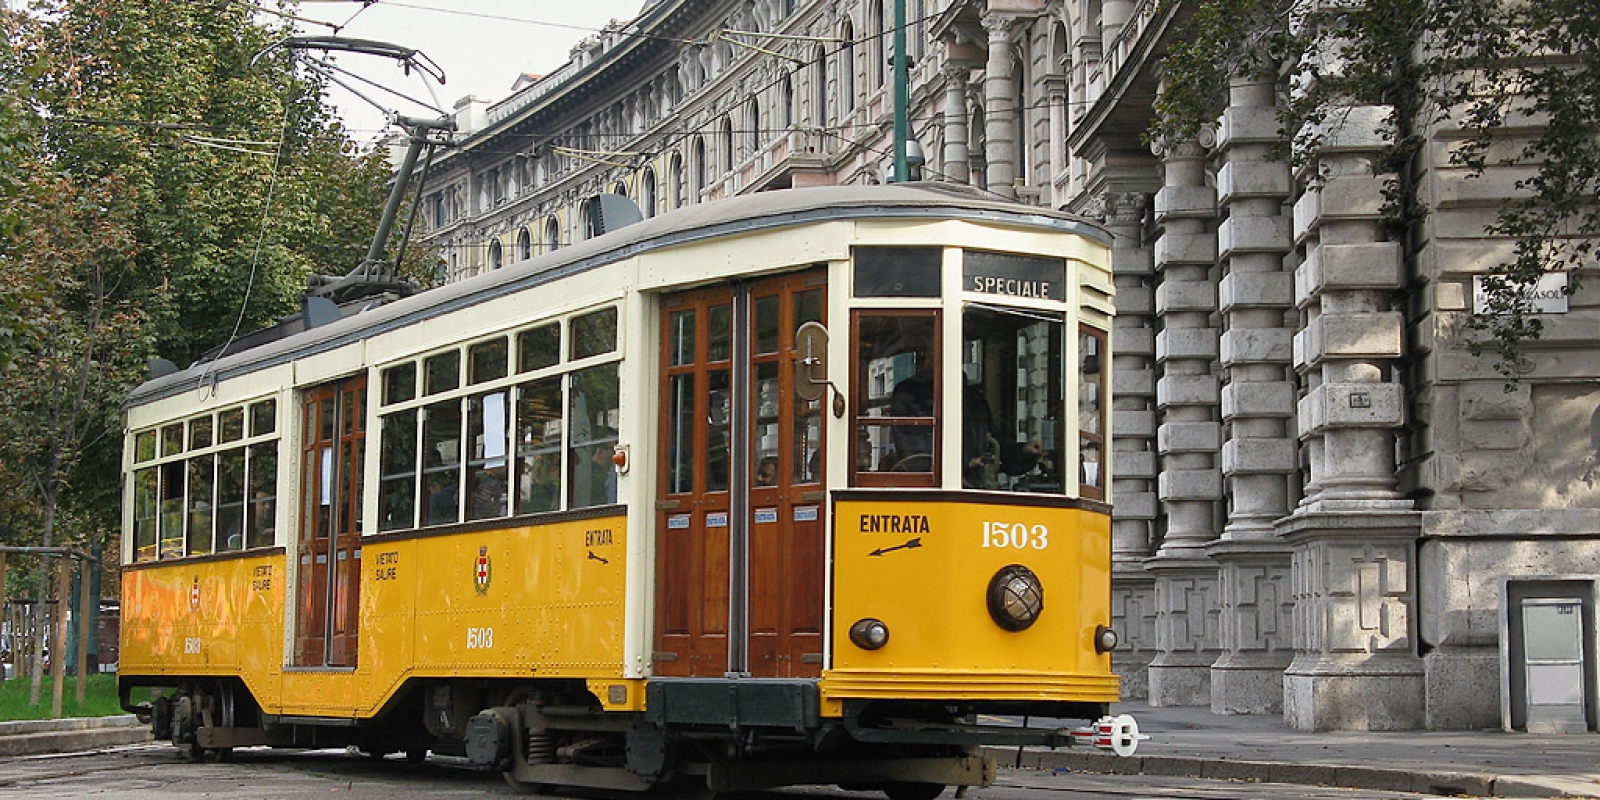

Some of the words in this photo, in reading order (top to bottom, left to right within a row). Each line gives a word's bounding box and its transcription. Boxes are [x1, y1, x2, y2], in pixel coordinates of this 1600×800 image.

[974, 276, 1050, 299] SPECIALE
[860, 514, 930, 534] ENTRATA
[585, 529, 613, 548] ENTRATA
[982, 521, 1049, 550] 1503
[375, 551, 399, 565] VIETATO
[375, 567, 397, 581] SALIRE
[466, 627, 493, 649] 1503
